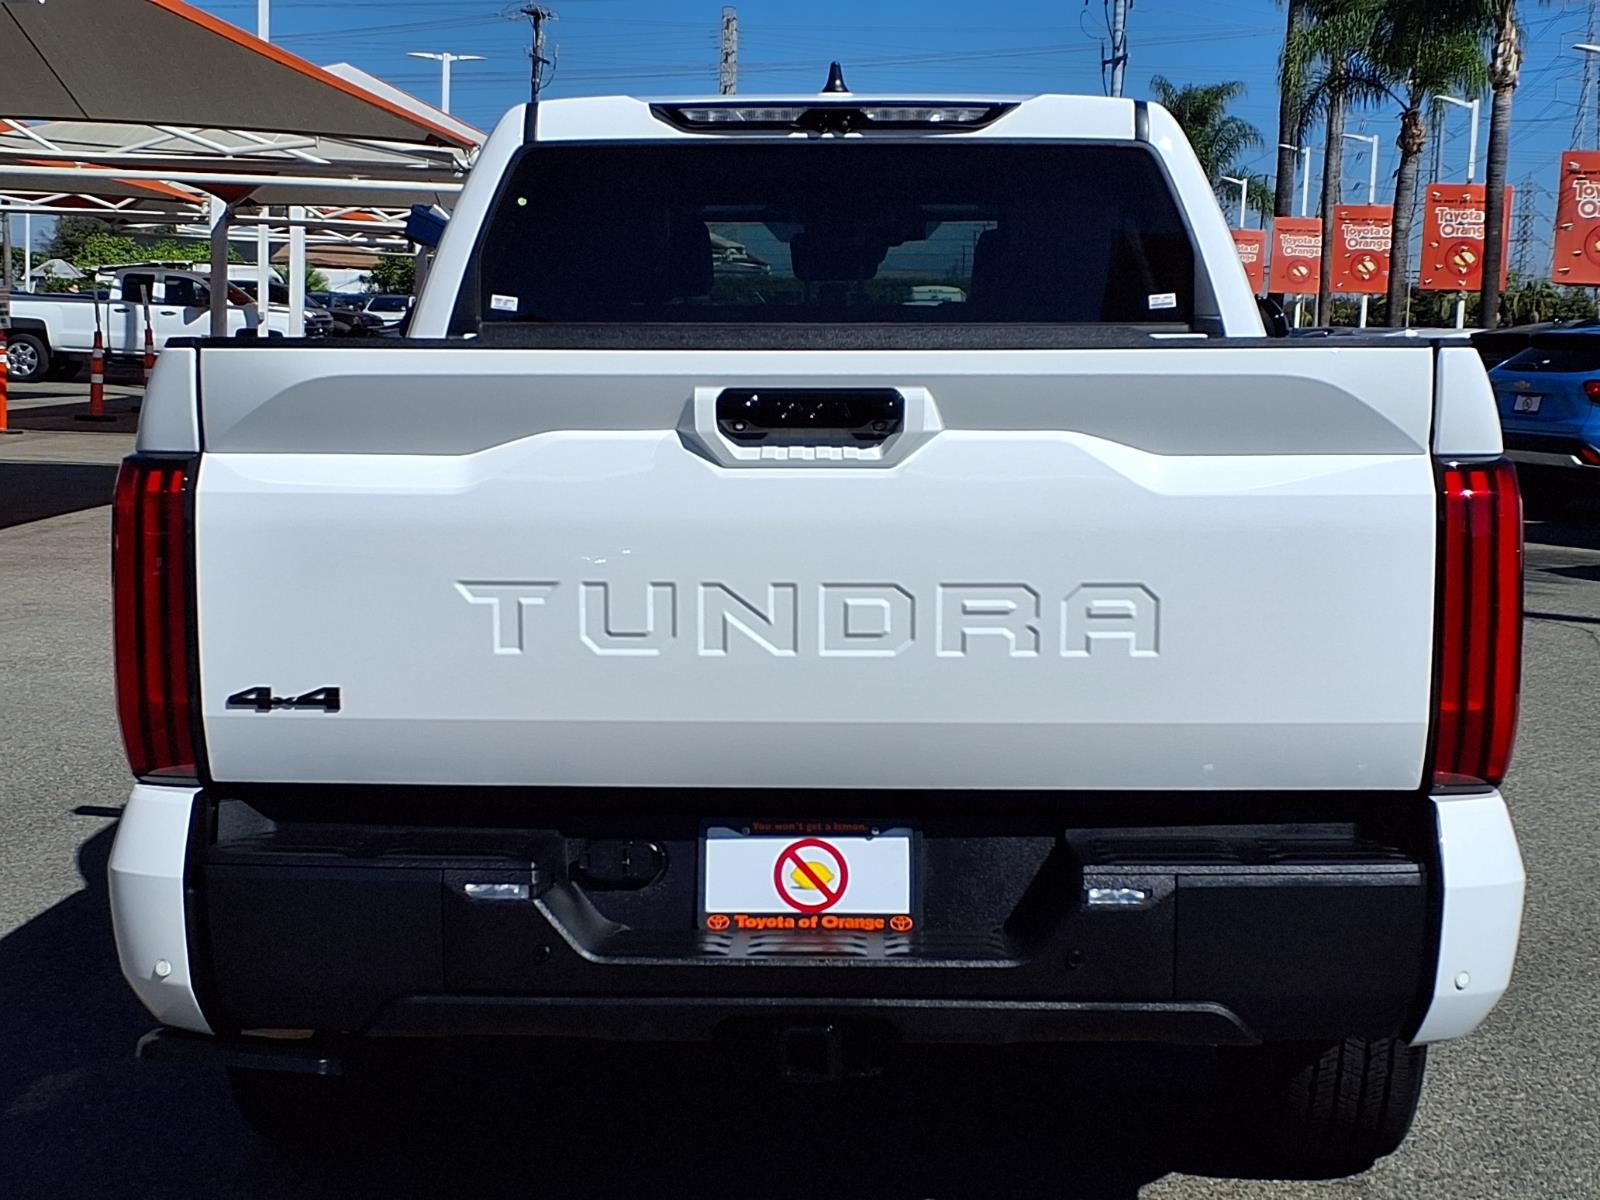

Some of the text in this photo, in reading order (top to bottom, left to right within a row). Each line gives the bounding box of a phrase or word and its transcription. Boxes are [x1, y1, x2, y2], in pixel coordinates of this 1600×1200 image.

[1436, 207, 1484, 223] Toyota
[1342, 224, 1392, 238] Toyota o
[1441, 223, 1484, 239] Orang
[1281, 234, 1321, 246] Toyota o
[1346, 238, 1391, 250] Orange
[1284, 246, 1321, 257] Orange
[455, 579, 1161, 658] TUNDRA
[225, 686, 341, 713] 4x4
[752, 822, 772, 831] You
[733, 915, 885, 930] Toyota of Orange
